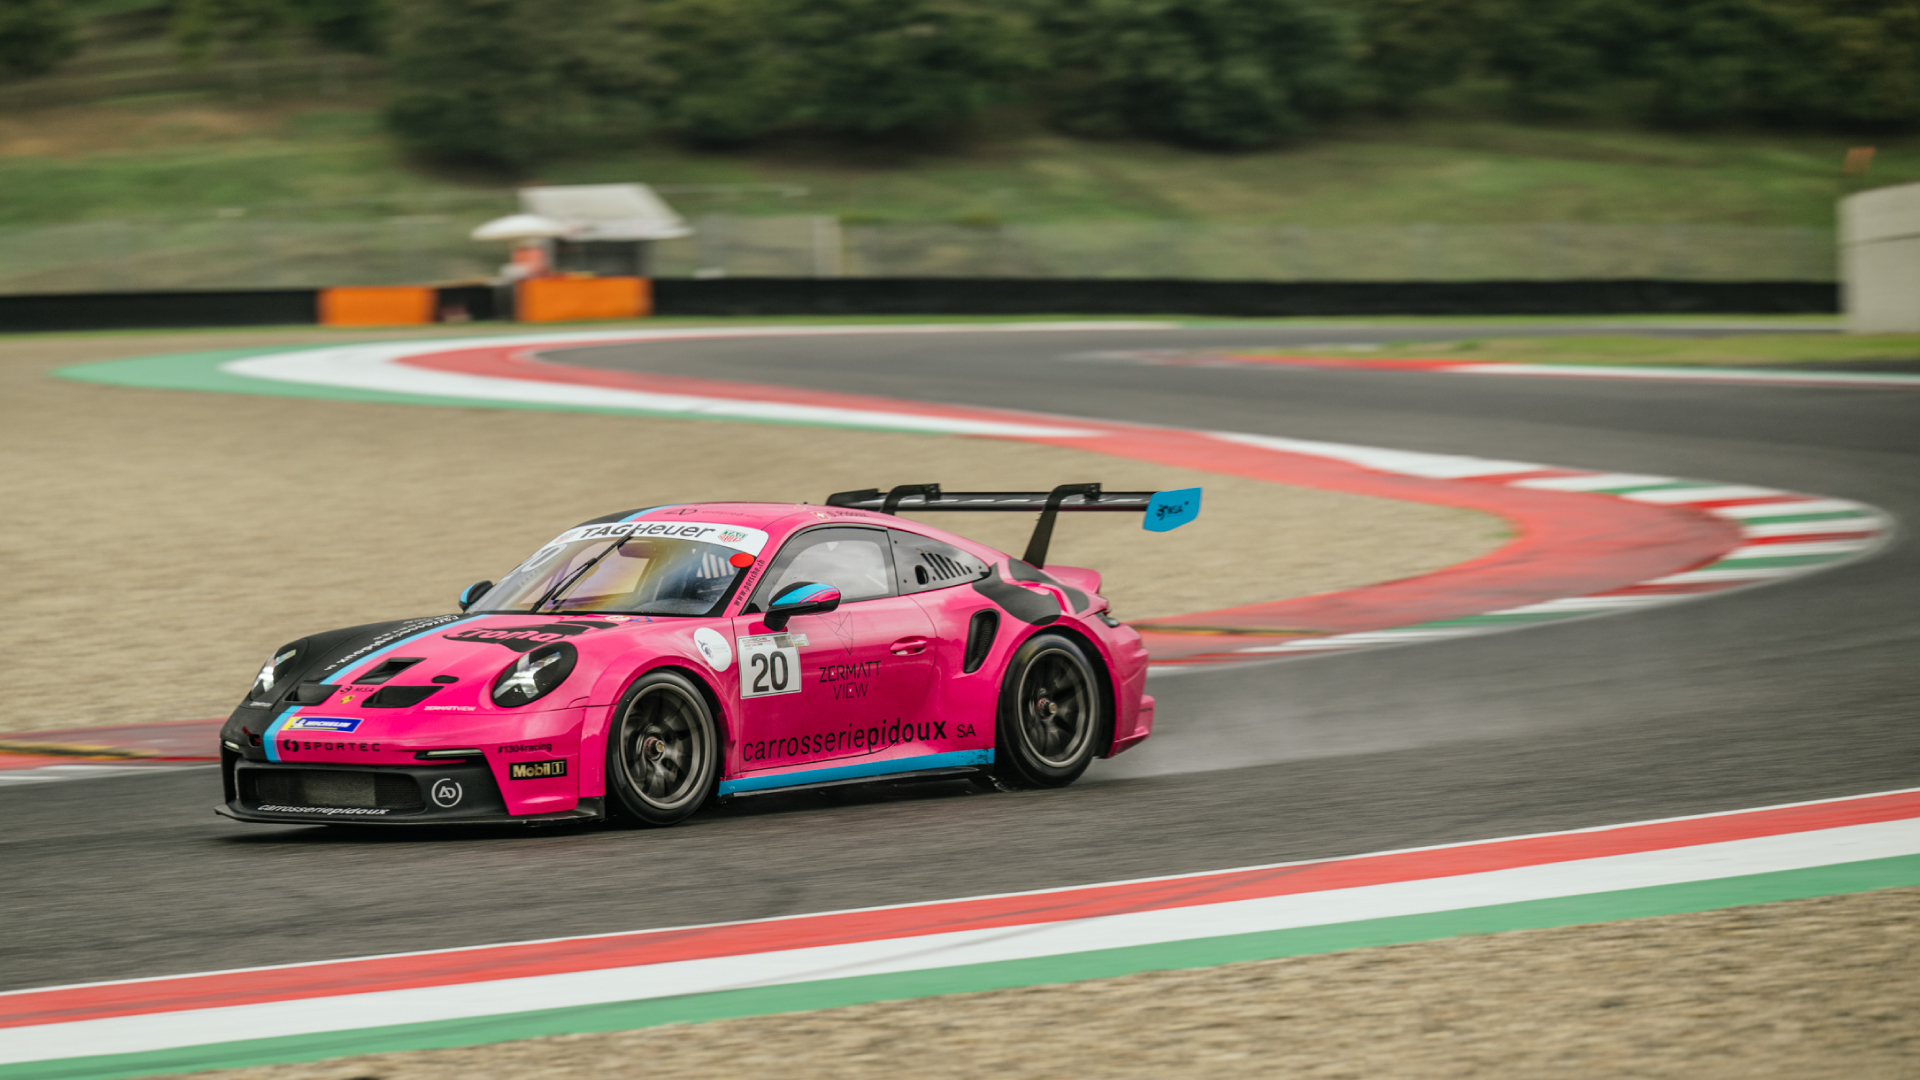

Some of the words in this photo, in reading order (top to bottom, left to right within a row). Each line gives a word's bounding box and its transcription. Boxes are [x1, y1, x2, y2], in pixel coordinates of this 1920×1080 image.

[733, 559, 765, 607] www.porsche.ch
[751, 651, 789, 693] 20
[818, 660, 882, 683] ZERMATT
[832, 680, 869, 700] VIEW
[305, 720, 352, 728] MICHELIN
[303, 742, 381, 751] SPORTEC
[498, 742, 552, 754] #1304racing
[743, 718, 947, 762] carrosseriepidoux
[956, 723, 977, 739] SA
[513, 763, 550, 778] Mobil
[258, 804, 390, 816] carrosseriepidoux
